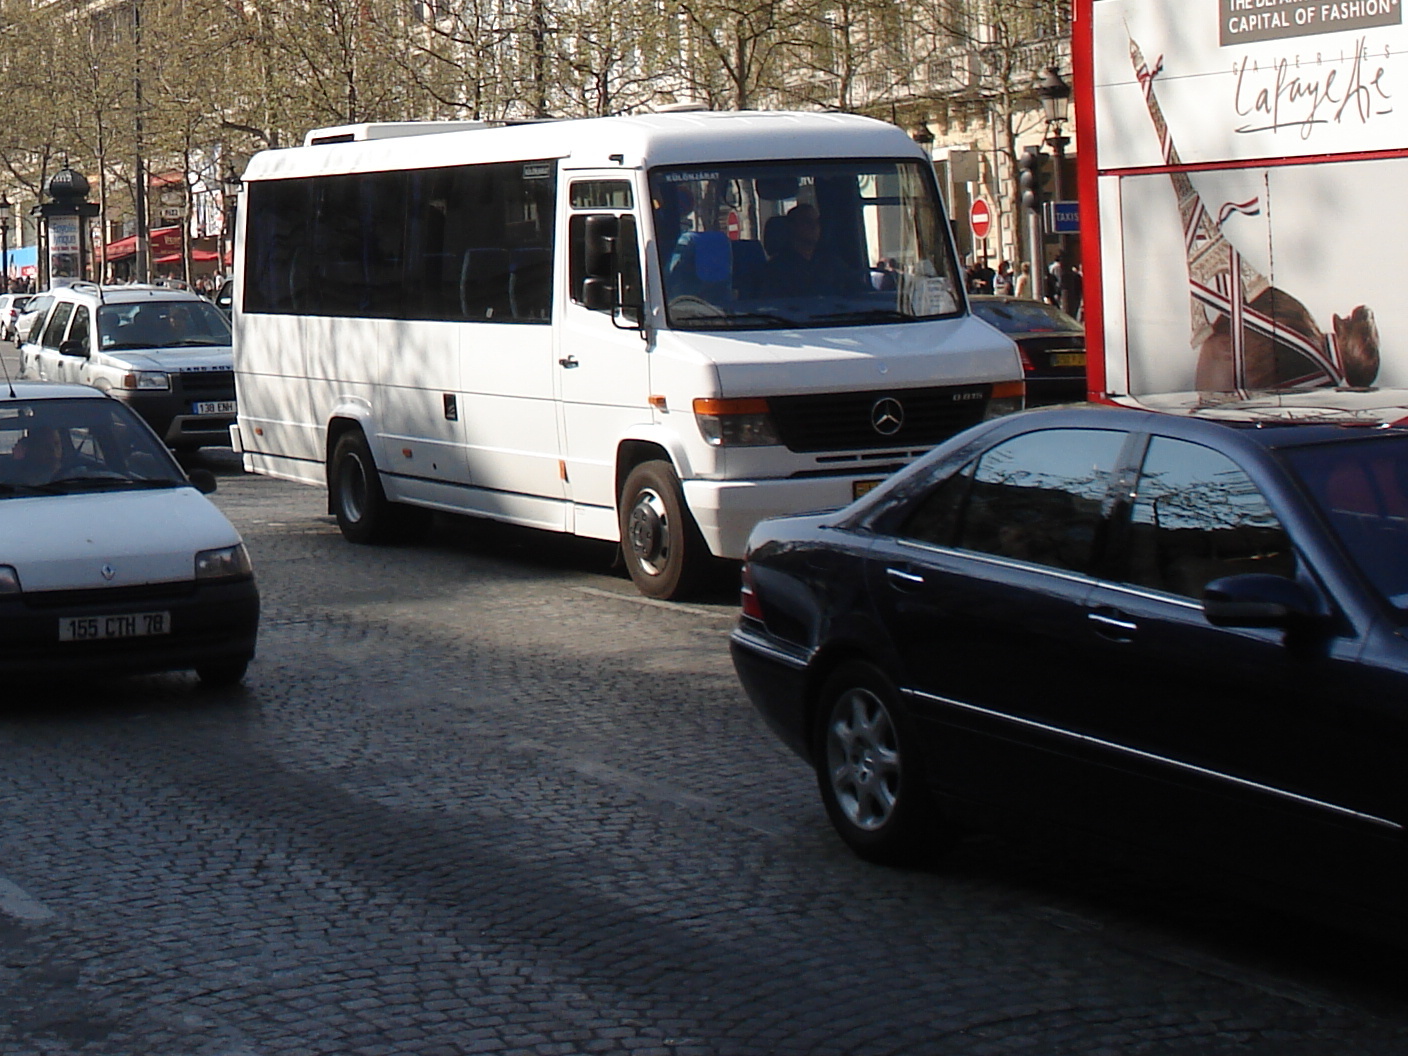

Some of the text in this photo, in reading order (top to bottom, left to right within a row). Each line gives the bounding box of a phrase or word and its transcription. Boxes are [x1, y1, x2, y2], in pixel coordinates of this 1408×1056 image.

[1229, 10, 1290, 34] CAPITAL
[1295, 7, 1316, 25] OF
[1233, 45, 1390, 75] GALERIES
[1056, 212, 1079, 223] TAXIS
[69, 614, 164, 638] 155 CTH 78
